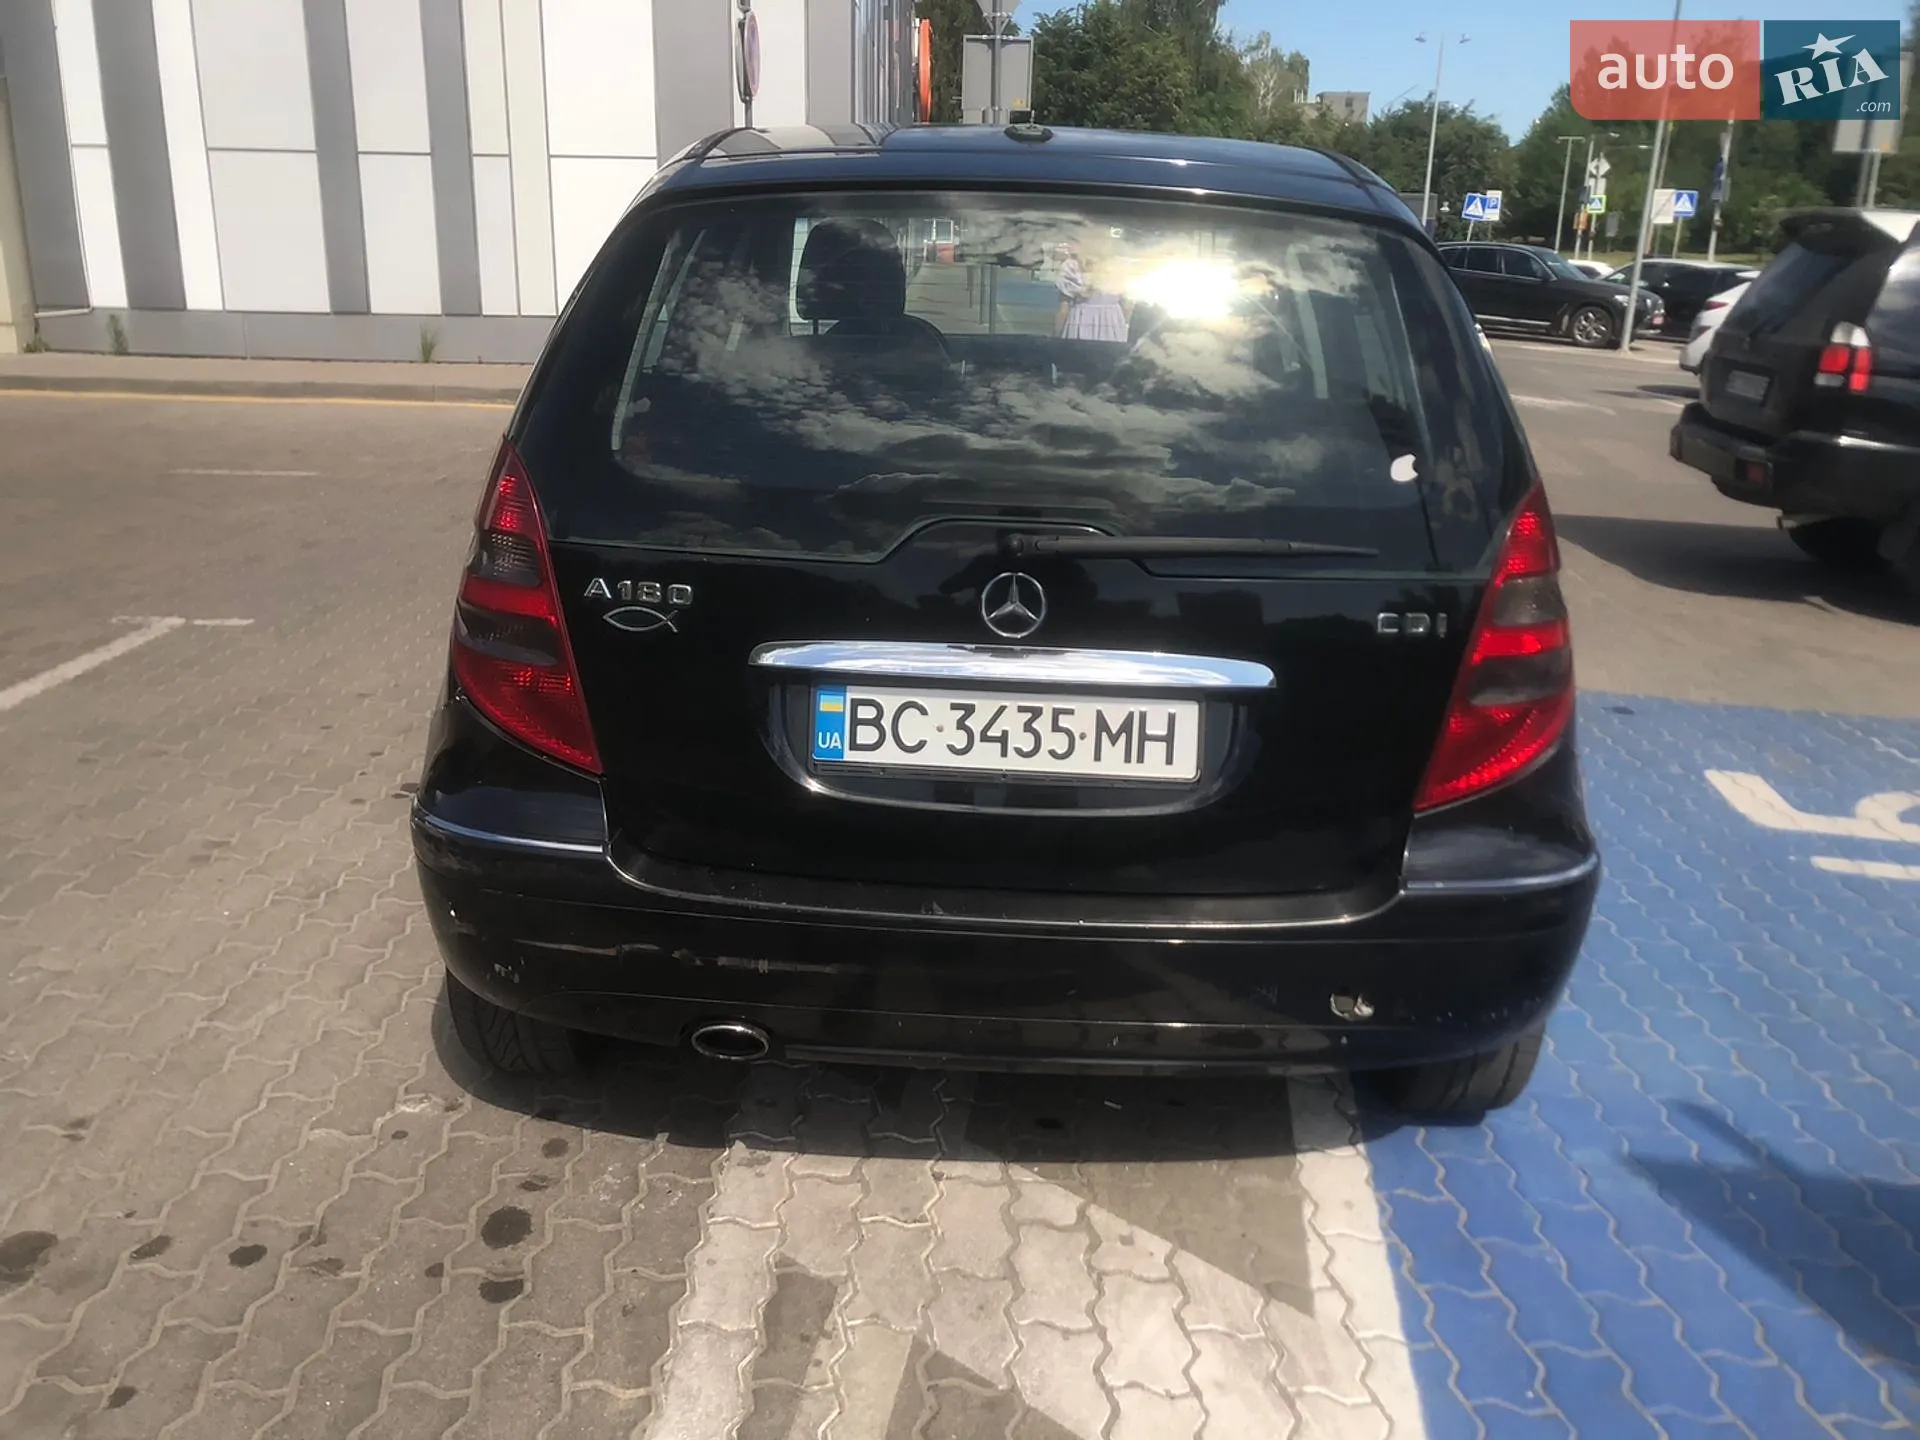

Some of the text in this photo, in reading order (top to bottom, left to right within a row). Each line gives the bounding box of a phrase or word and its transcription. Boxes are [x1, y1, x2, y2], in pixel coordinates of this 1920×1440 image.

[1377, 612, 1448, 638] CDI
[818, 731, 842, 749] UA
[849, 698, 1176, 765] BC 3435 MH
